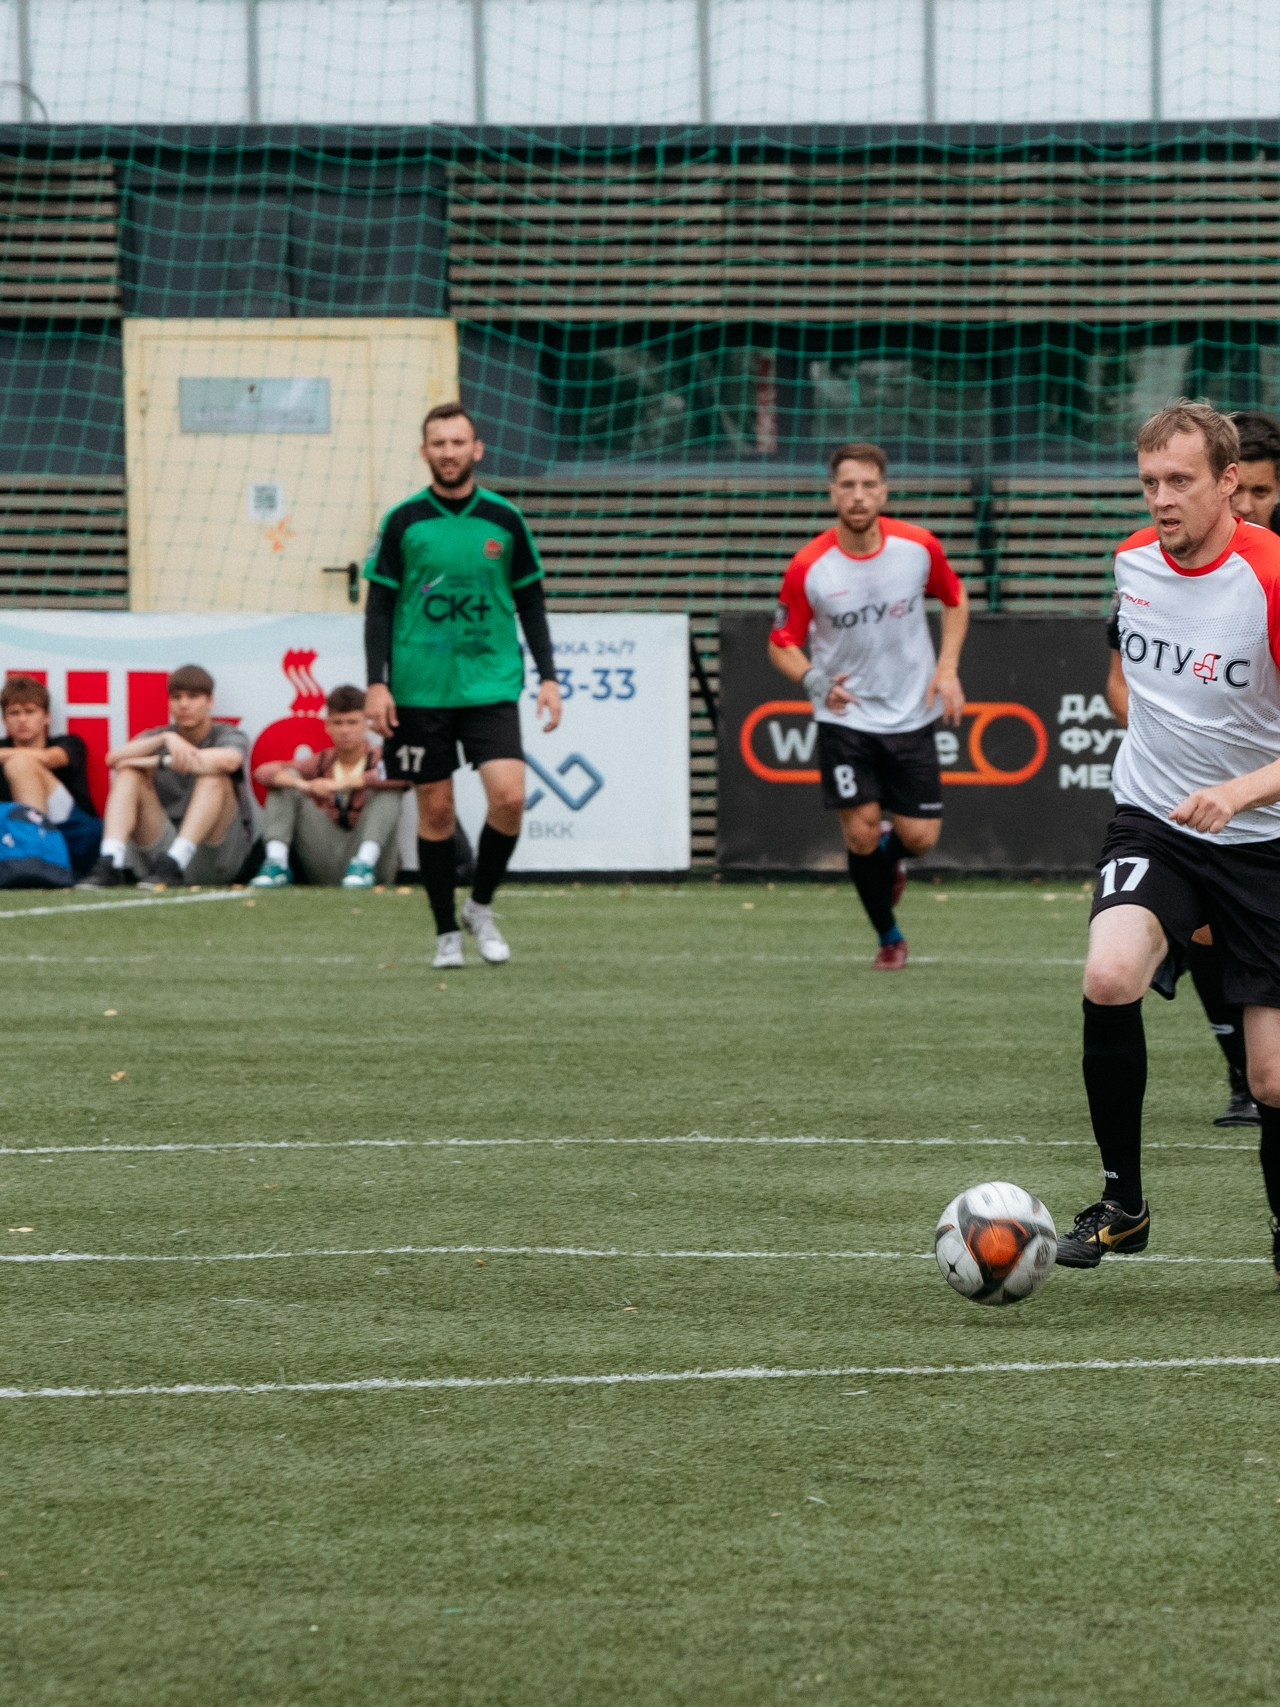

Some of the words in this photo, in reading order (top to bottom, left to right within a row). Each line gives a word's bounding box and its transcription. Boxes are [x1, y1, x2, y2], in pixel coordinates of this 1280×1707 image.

[396, 744, 426, 773] 17
[833, 764, 857, 799] 8
[1100, 857, 1150, 899] 17
